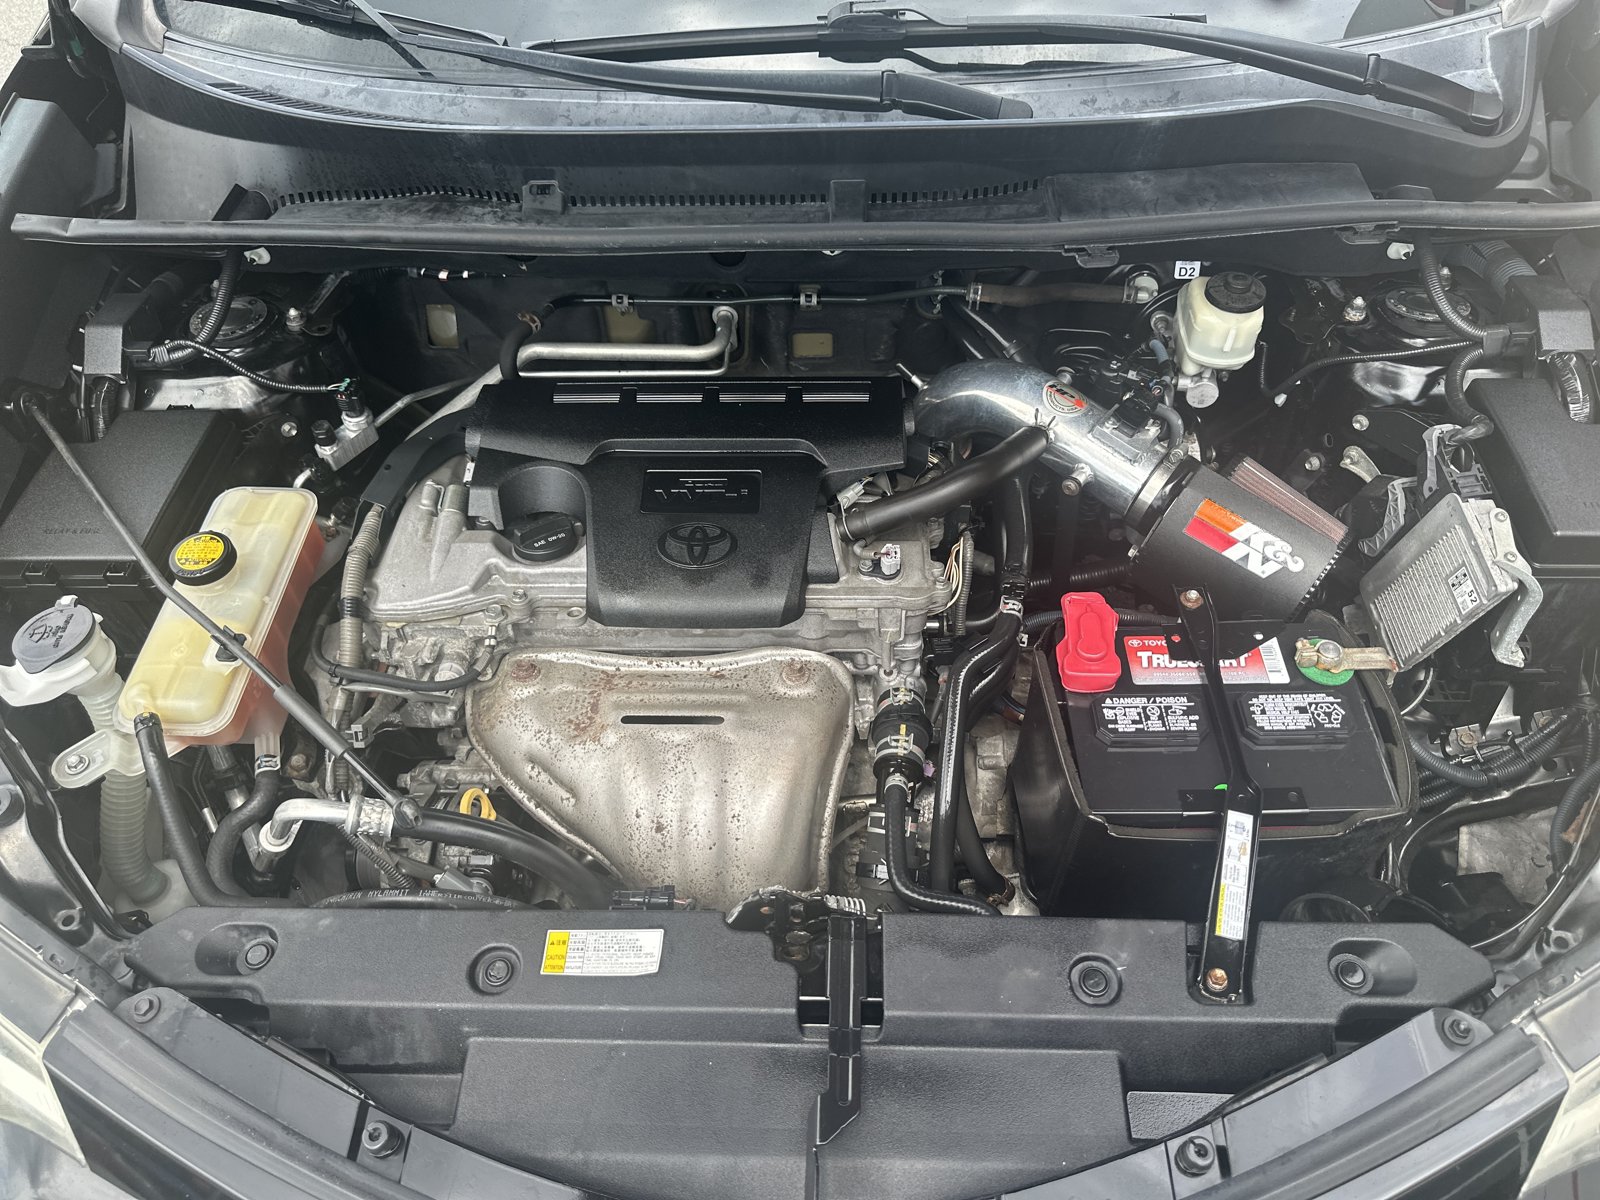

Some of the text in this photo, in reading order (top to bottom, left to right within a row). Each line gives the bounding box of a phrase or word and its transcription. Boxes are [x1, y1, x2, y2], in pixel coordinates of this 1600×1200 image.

[1178, 267, 1196, 277] D2
[533, 539, 546, 548] SAE
[1468, 590, 1477, 605] 52
[1155, 696, 1188, 704] POISON
